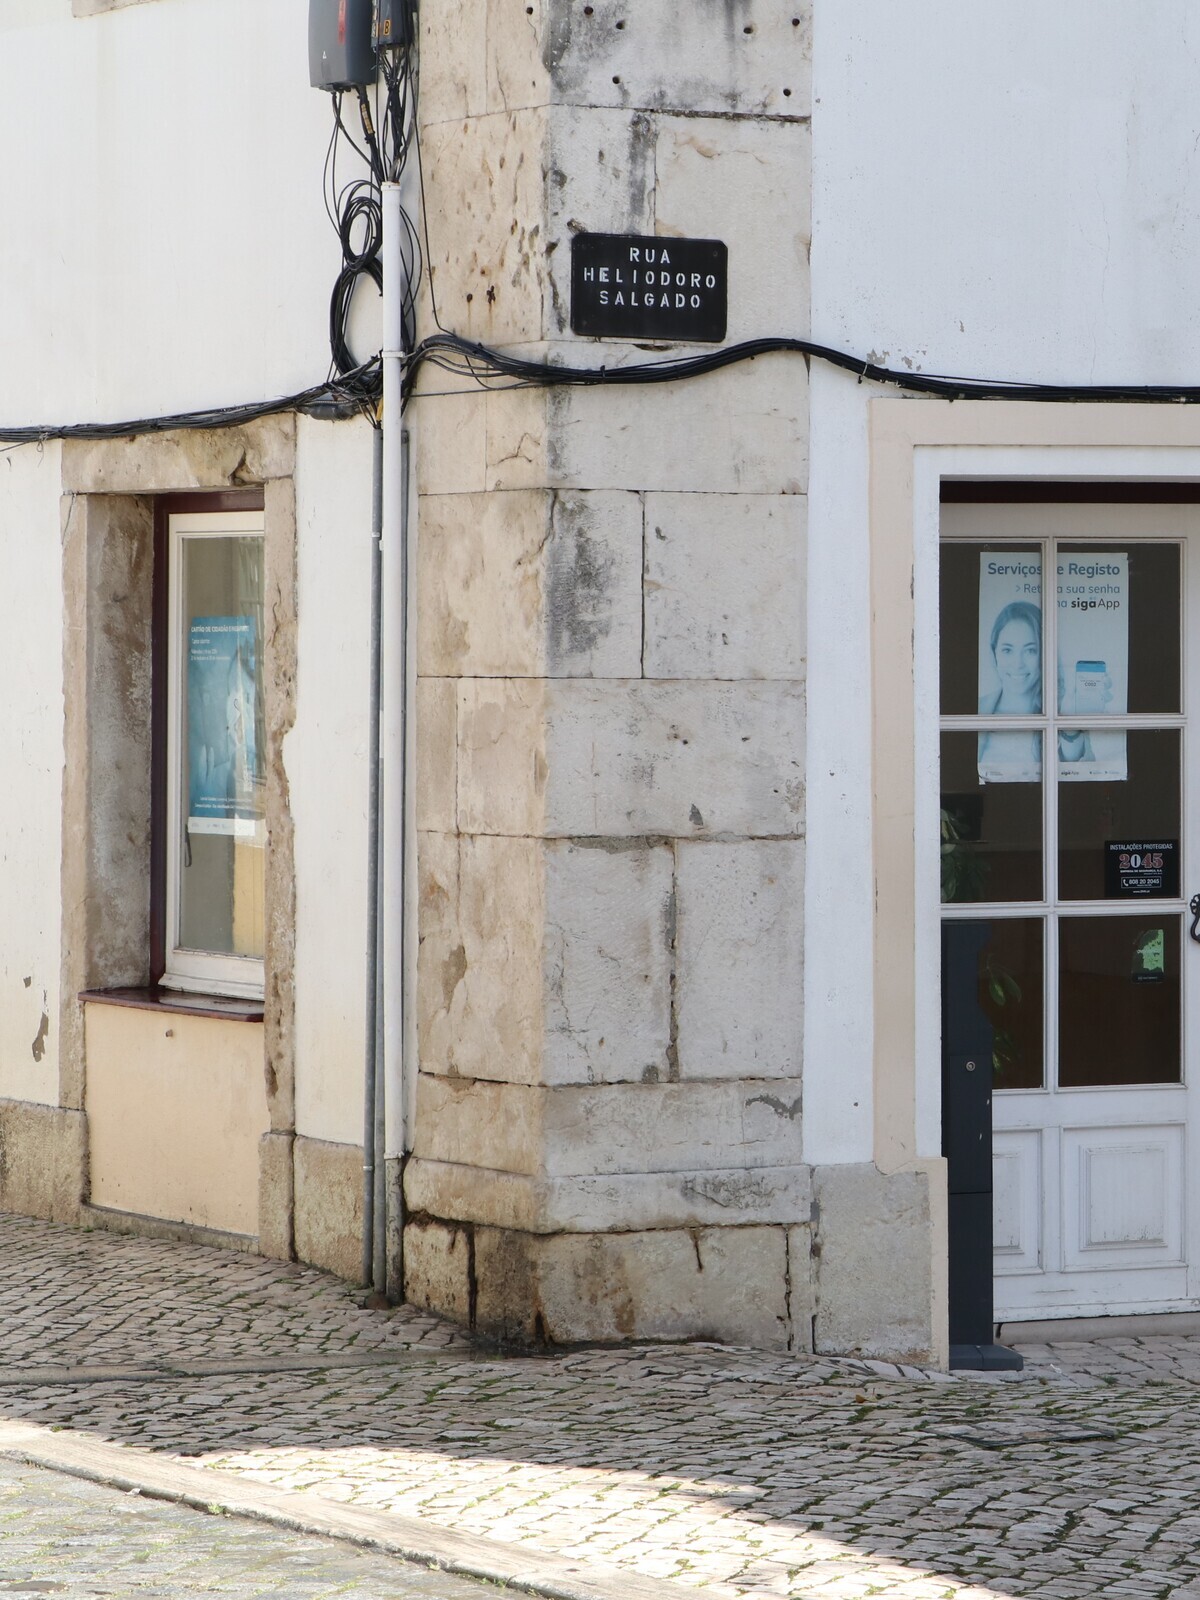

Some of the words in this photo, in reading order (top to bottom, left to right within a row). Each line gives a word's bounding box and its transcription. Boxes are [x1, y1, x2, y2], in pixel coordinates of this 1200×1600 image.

[629, 247, 671, 264] RUA
[583, 267, 716, 289] HELIODORO
[599, 290, 701, 309] SALGADO
[987, 562, 1042, 578] Serviços
[1068, 562, 1121, 579] Registo
[1066, 585, 1085, 594] sua
[1088, 583, 1121, 594] senha
[1109, 843, 1142, 851] INSTALAÇÕES
[1118, 853, 1164, 869] 2045
